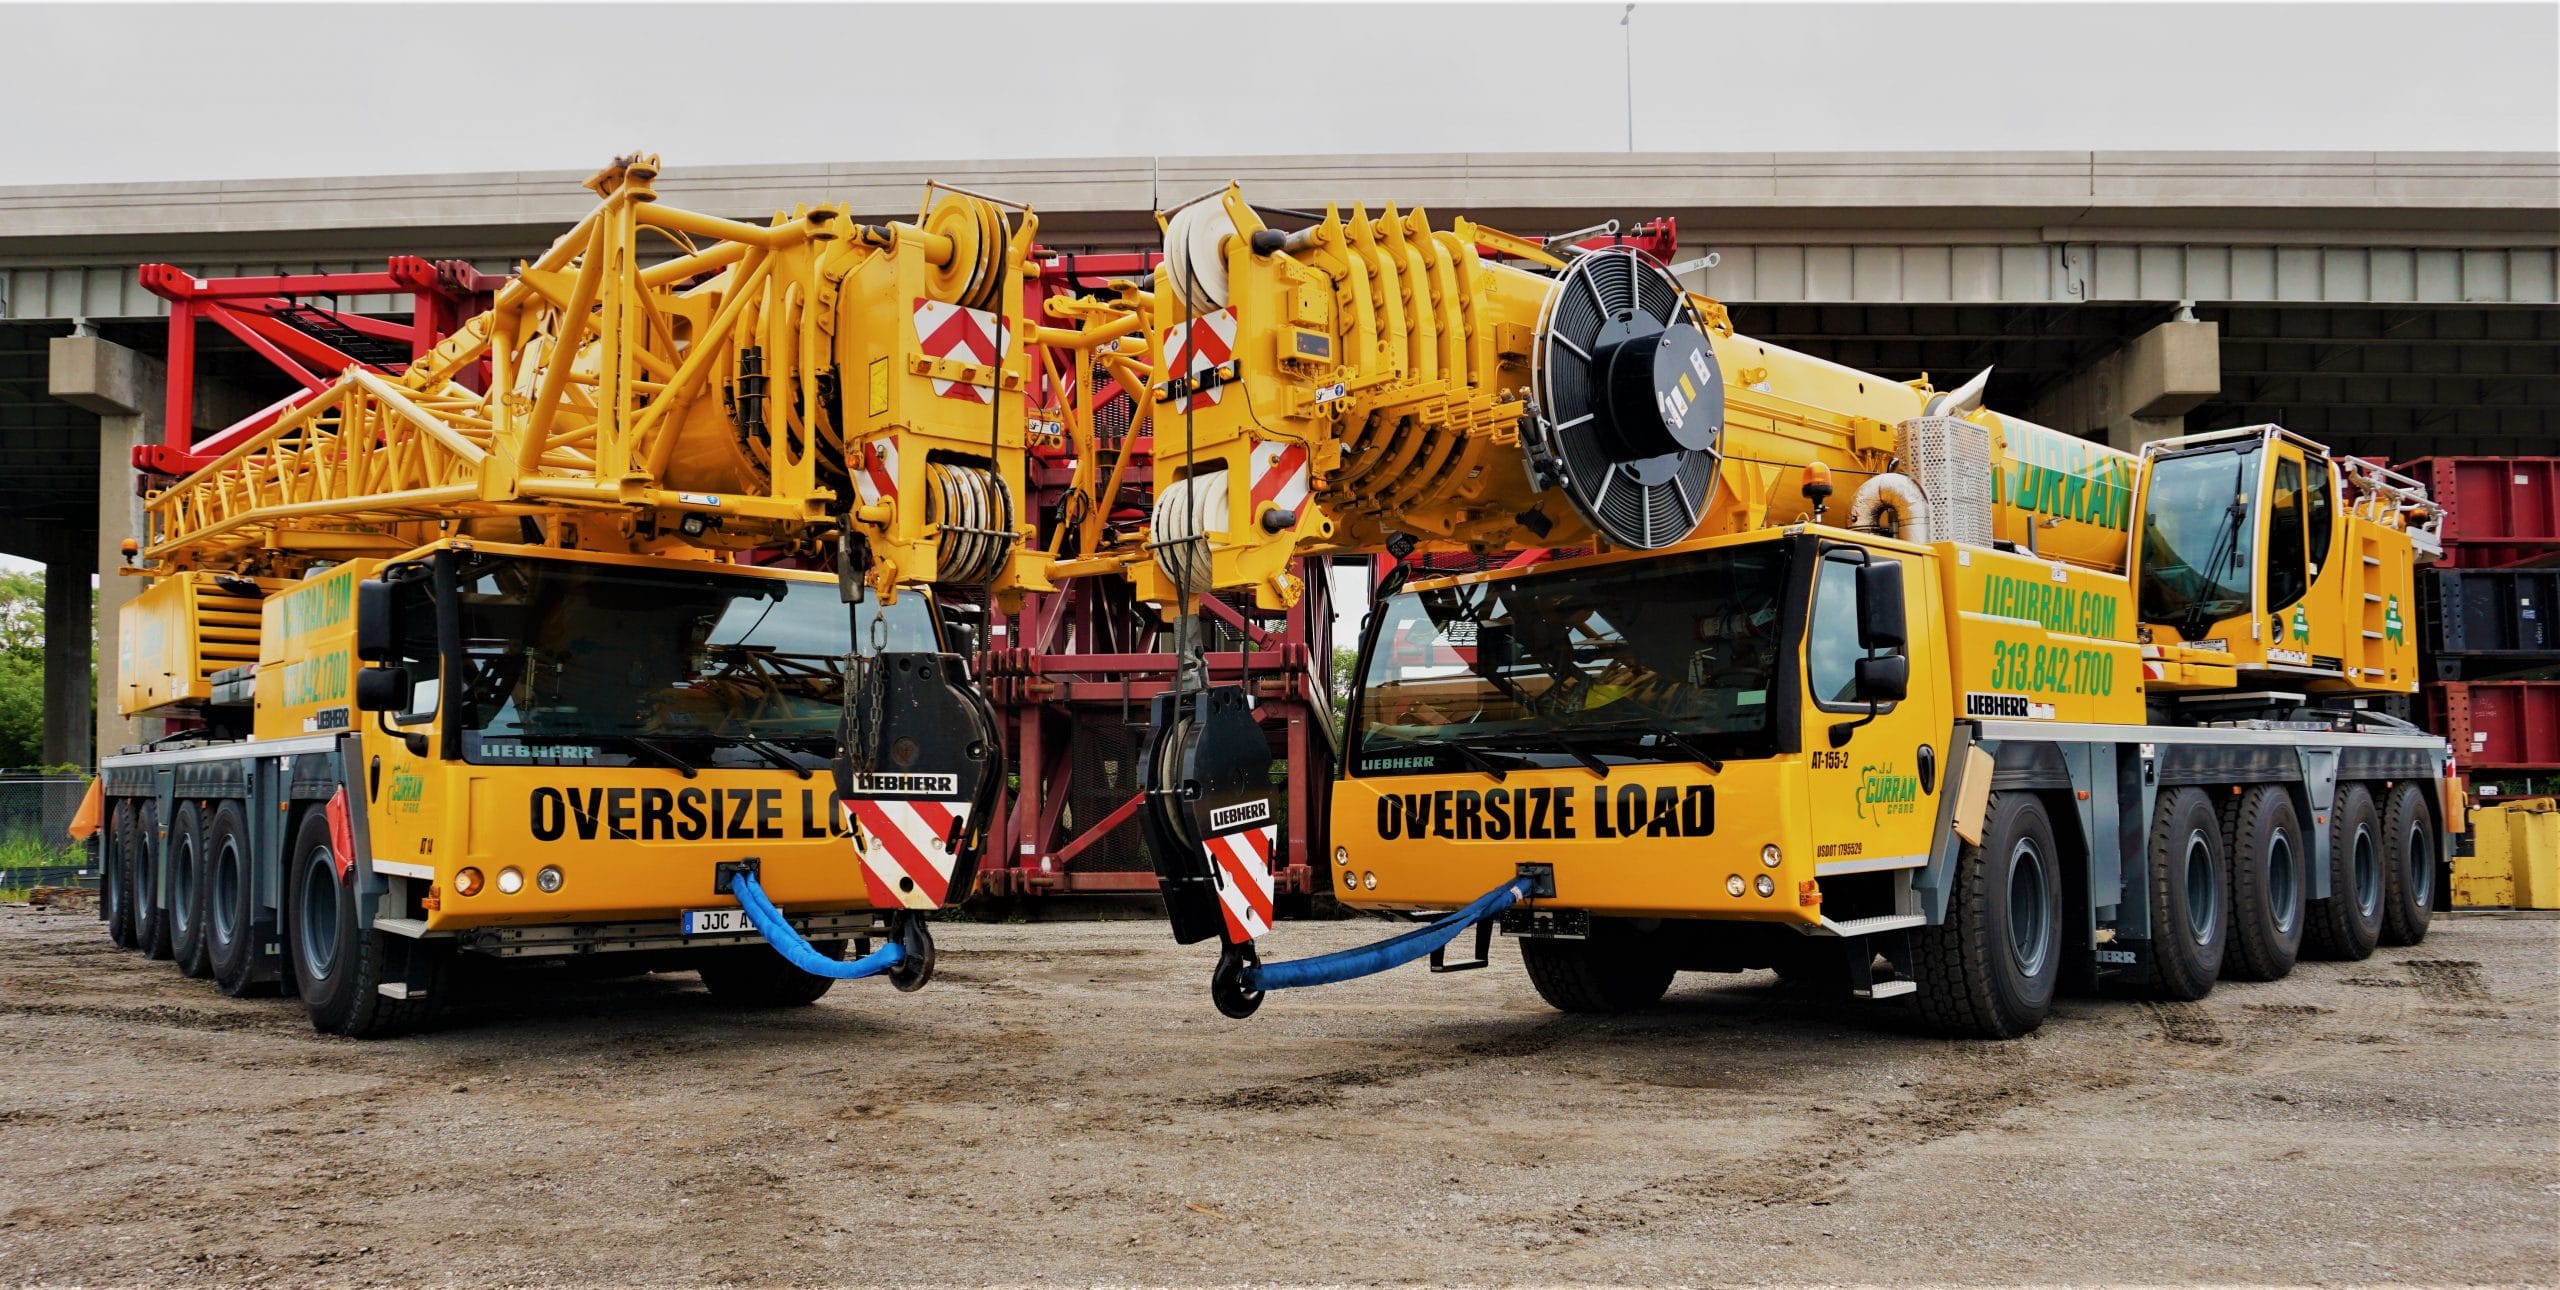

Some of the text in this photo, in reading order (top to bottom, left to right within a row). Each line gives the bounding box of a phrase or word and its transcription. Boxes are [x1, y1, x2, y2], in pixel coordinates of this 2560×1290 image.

[1992, 640, 2113, 697] 313.842.1700
[1967, 694, 2028, 717] LIEBHERR
[480, 744, 594, 759] LIEBHERR
[1811, 752, 1849, 769] AT-155-2
[1361, 756, 1434, 771] LIEBHERR
[858, 776, 952, 791] LIEBHERR
[1865, 776, 1917, 803] CURRAN
[529, 786, 848, 842] OVERSIZE LO
[1213, 803, 1267, 827] LIEBHERR
[1377, 783, 1715, 841] OVERSIZE LOAD
[1817, 845, 1836, 857] USDOT
[702, 913, 729, 930] JJC
